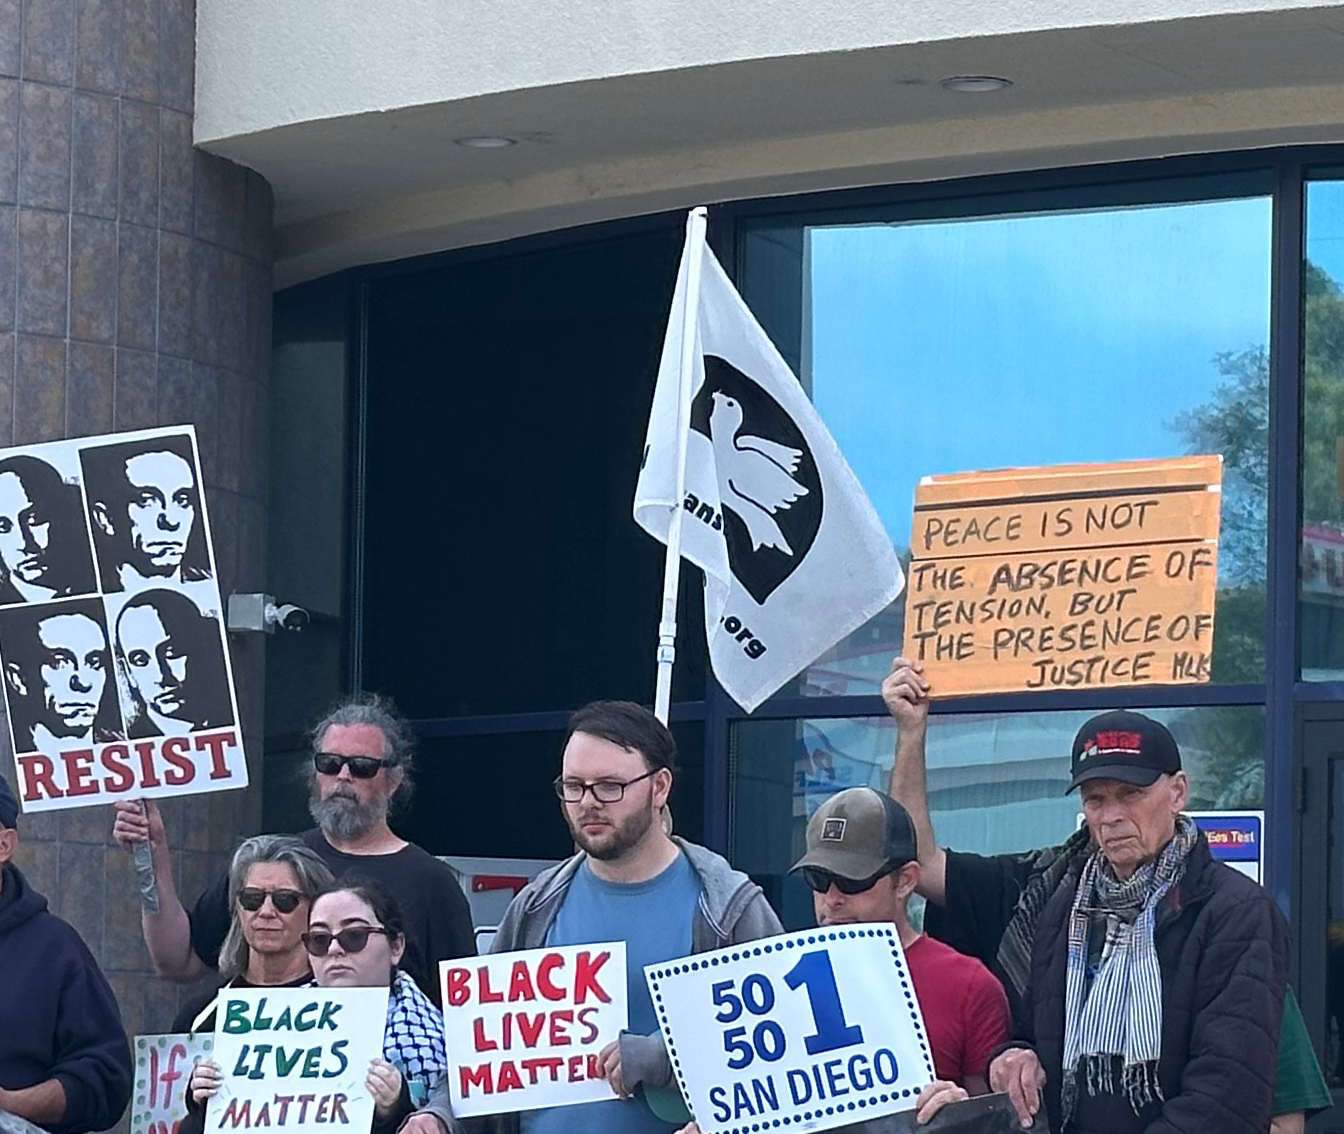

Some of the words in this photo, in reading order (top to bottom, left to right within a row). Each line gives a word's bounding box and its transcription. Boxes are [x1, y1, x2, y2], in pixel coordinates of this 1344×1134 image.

[924, 515, 1021, 550] PEACE
[1040, 507, 1074, 537] IS
[1085, 500, 1159, 531] NOT
[912, 562, 966, 592] THE
[987, 554, 1150, 595] ABSENCE
[1165, 548, 1213, 581] OF
[912, 593, 1050, 633] TENSION,
[1069, 588, 1137, 616] BUT
[911, 631, 975, 661] THE
[992, 614, 1162, 660] PRESENCE
[1166, 614, 1212, 642] OF
[1026, 651, 1155, 689] JUSTICE
[1171, 652, 1212, 683] MLK
[18, 731, 236, 802] RESIST
[446, 951, 612, 1007] BLACK
[711, 973, 775, 1023] 50
[783, 949, 867, 1056] 1
[222, 997, 344, 1035] BLACK
[473, 1007, 600, 1053] LIVES
[232, 1040, 350, 1080] LIVES
[722, 1019, 787, 1070] 50
[709, 1071, 780, 1123] SAN
[787, 1048, 899, 1106] DIEGO
[218, 1093, 350, 1129] MATTER
